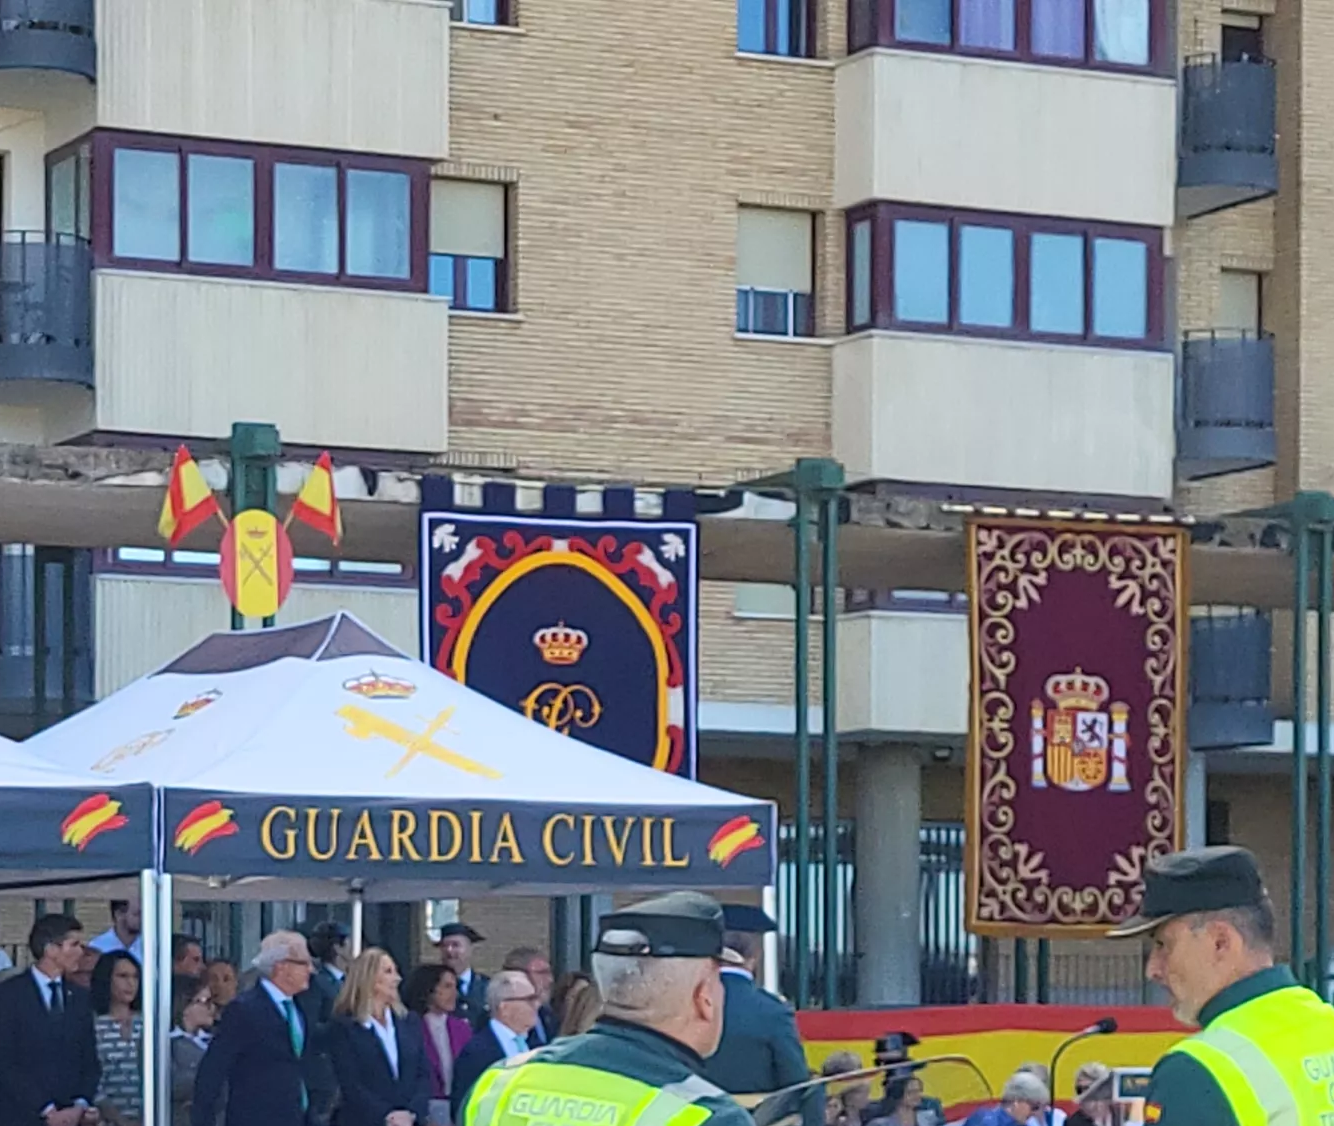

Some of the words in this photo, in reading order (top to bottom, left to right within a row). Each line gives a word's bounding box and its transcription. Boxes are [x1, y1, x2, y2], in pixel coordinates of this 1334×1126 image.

[260, 805, 526, 864] GUARDIA
[542, 812, 690, 868] CIVIL
[511, 1093, 617, 1126] GUARDIA
